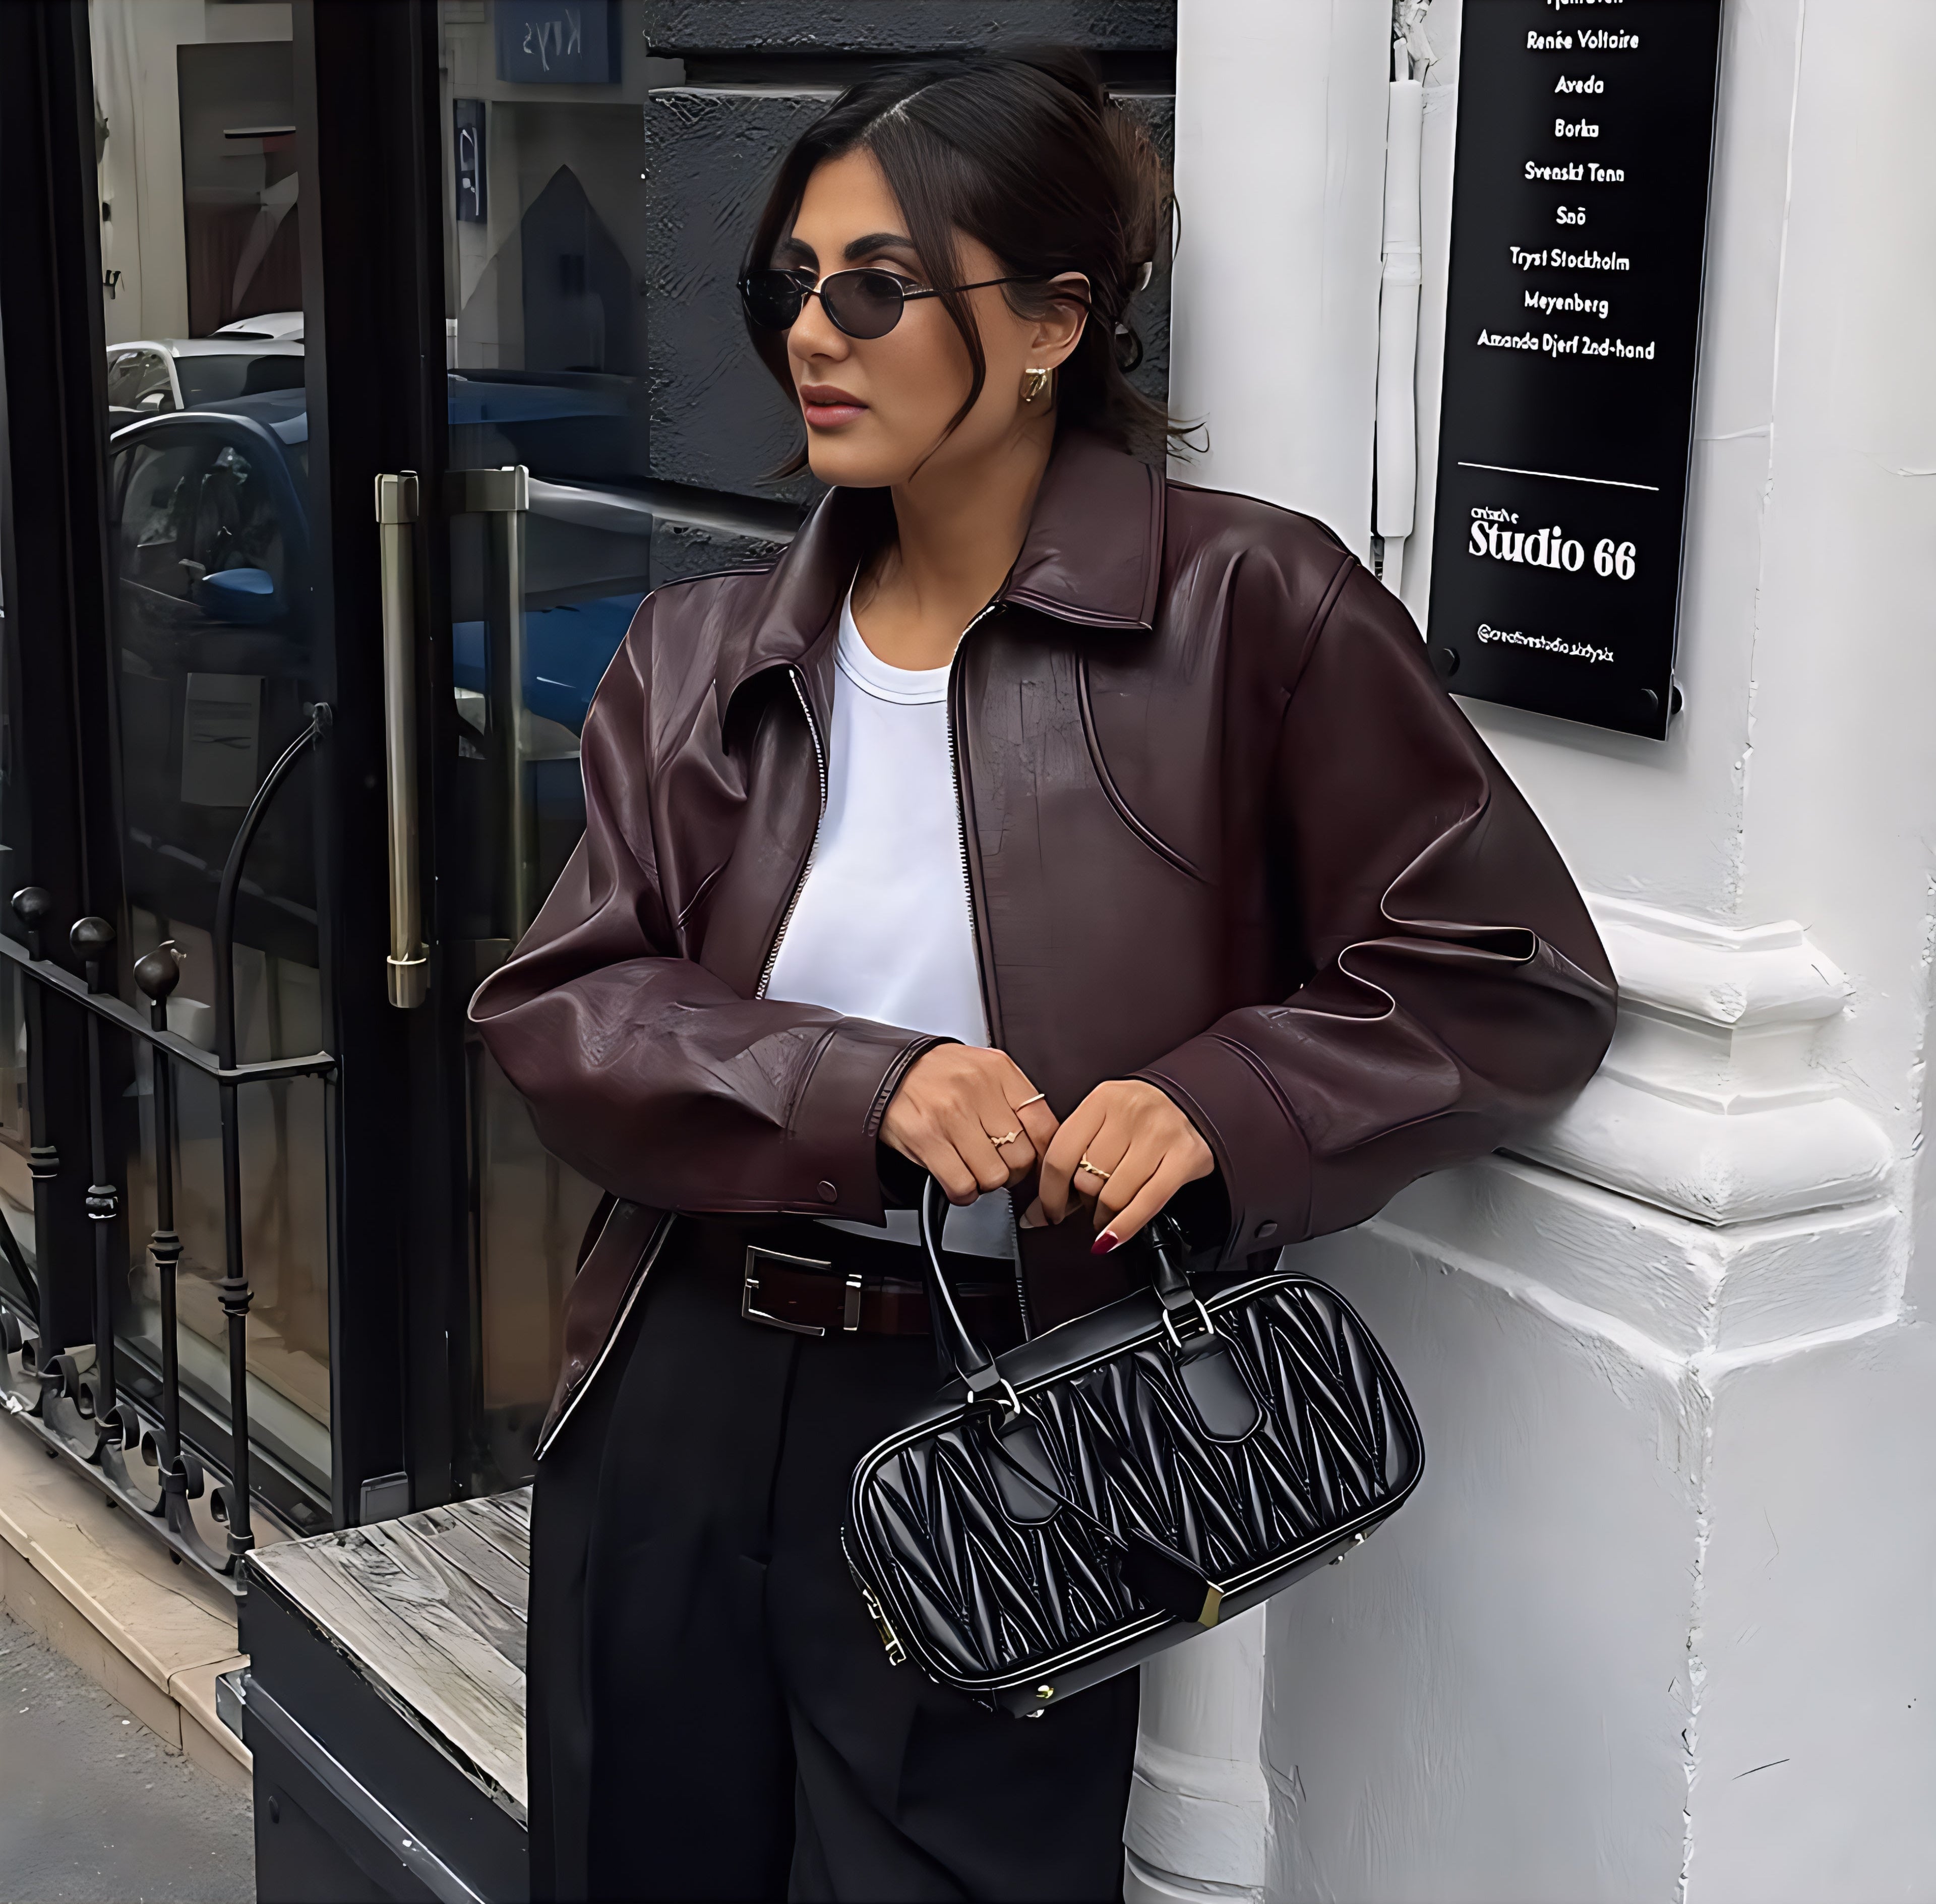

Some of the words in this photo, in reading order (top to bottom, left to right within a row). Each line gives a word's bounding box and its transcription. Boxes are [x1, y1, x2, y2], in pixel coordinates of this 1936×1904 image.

[1578, 30, 1639, 48] Voltaire
[1551, 249, 1629, 270] Stockholm
[1525, 290, 1608, 319] Meyenberg
[1469, 520, 1584, 571] Studio
[1594, 539, 1636, 580] 66
